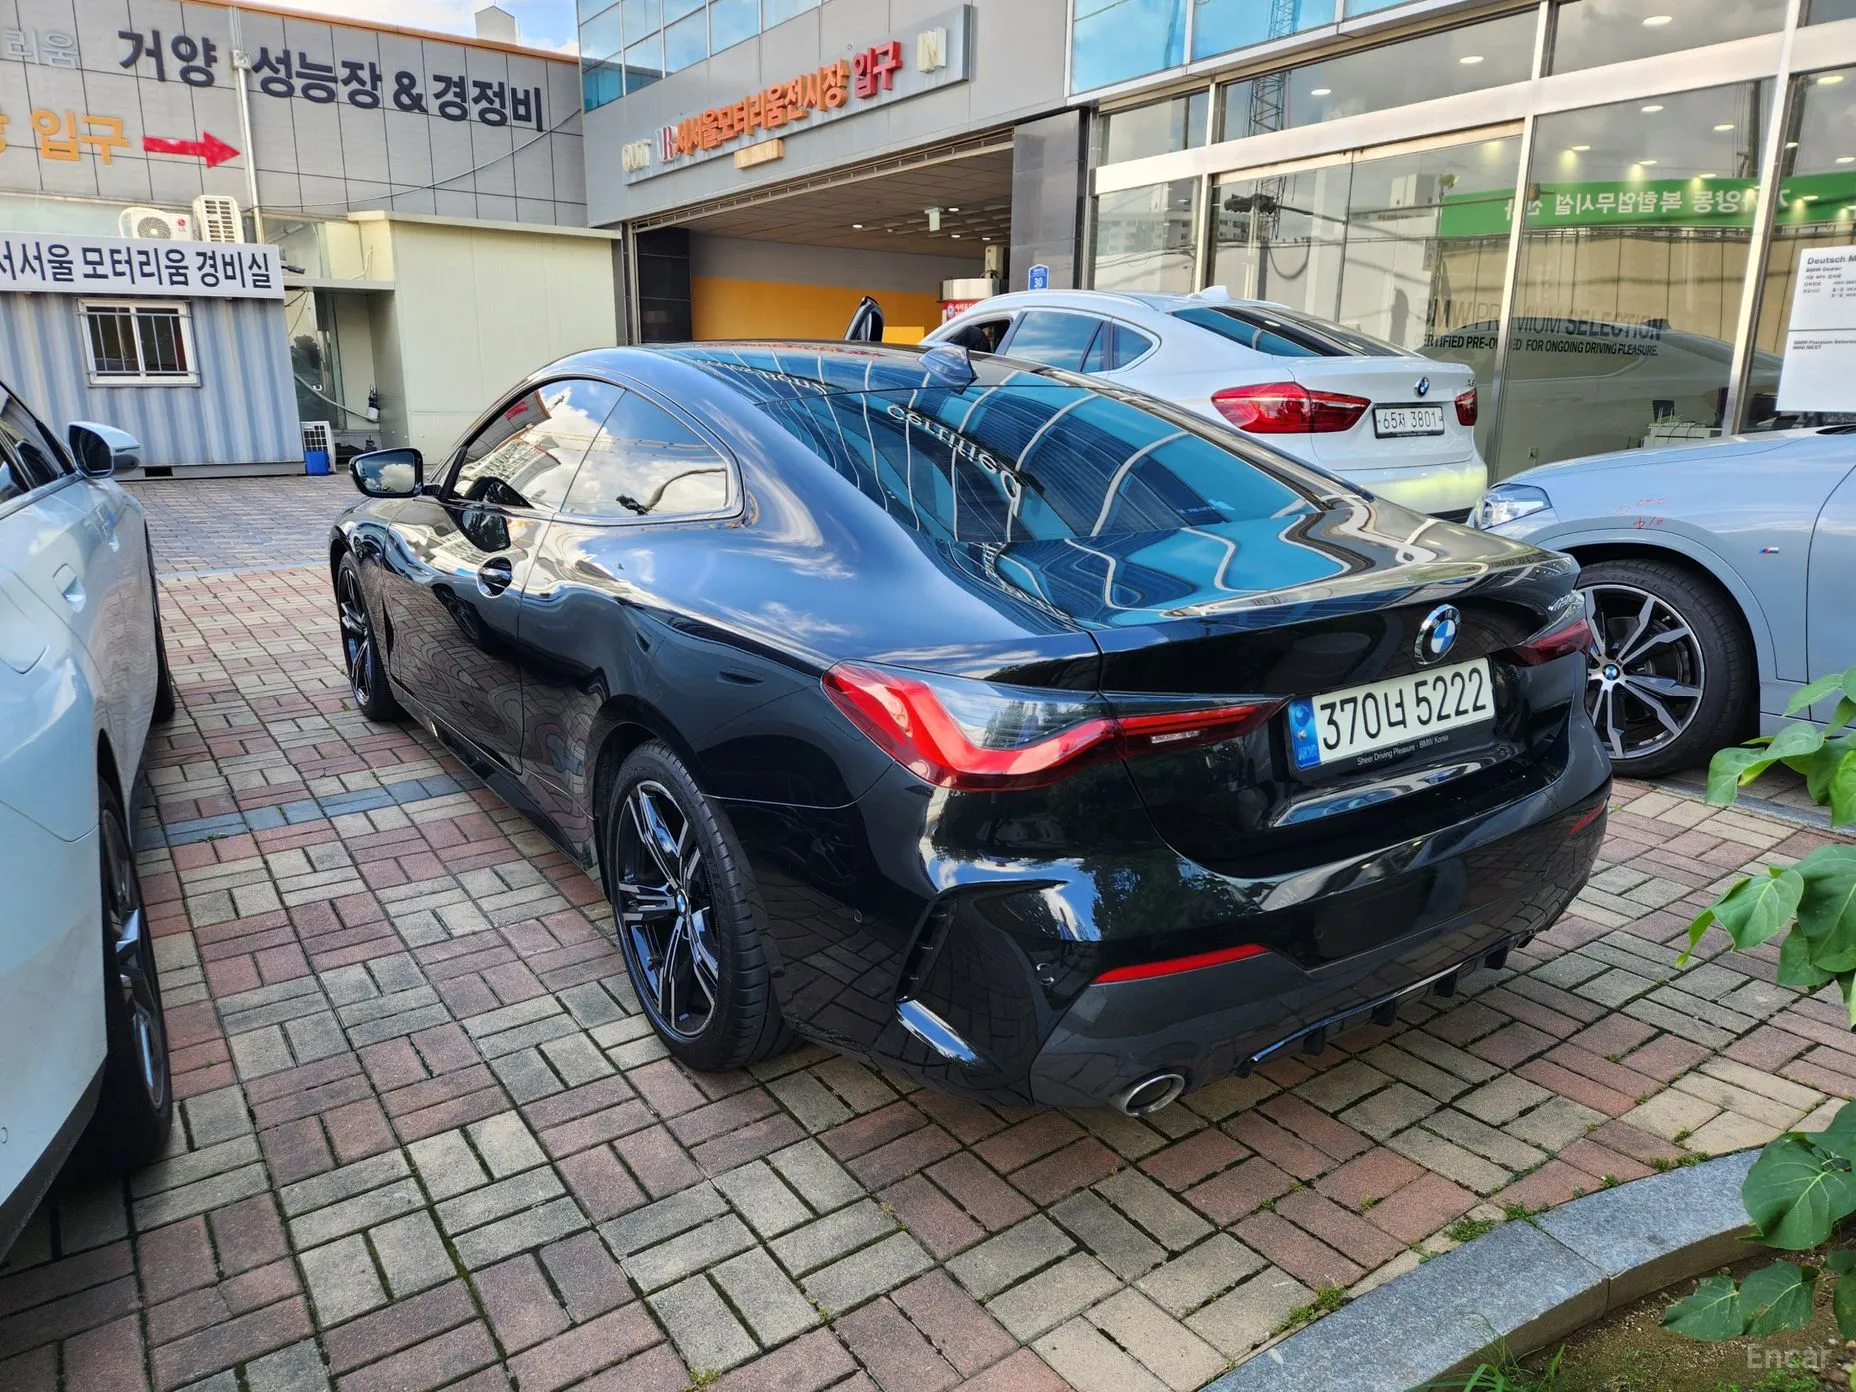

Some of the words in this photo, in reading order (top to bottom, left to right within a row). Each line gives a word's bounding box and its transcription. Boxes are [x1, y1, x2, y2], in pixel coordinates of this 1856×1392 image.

[3, 28, 79, 70] 리움
[917, 27, 948, 73] IN
[118, 30, 218, 87] 거양
[252, 47, 382, 109] 성능장
[393, 71, 428, 113] &
[433, 74, 543, 132] 경정비
[675, 59, 849, 157] 서서울모터리움전시장
[852, 40, 903, 100] 입구
[31, 109, 130, 165] 입구
[81, 245, 189, 286] 모터리움
[197, 250, 272, 289] 경비실
[1807, 255, 1846, 265] Deutsch
[1034, 276, 1043, 288] 30
[1526, 339, 1544, 351] FOR
[1546, 340, 1585, 353] ONGOING
[1585, 342, 1617, 355] DRIVING
[1383, 412, 1406, 429] 65저
[1411, 411, 1436, 428] 3801
[1320, 689, 1407, 751] 370너
[1415, 667, 1487, 726] 5222
[1357, 755, 1374, 766] Sheer
[1374, 751, 1393, 762] Driving
[1393, 743, 1415, 755] Pleasure
[1419, 738, 1433, 749] BMW
[1434, 735, 1449, 745] Korea
